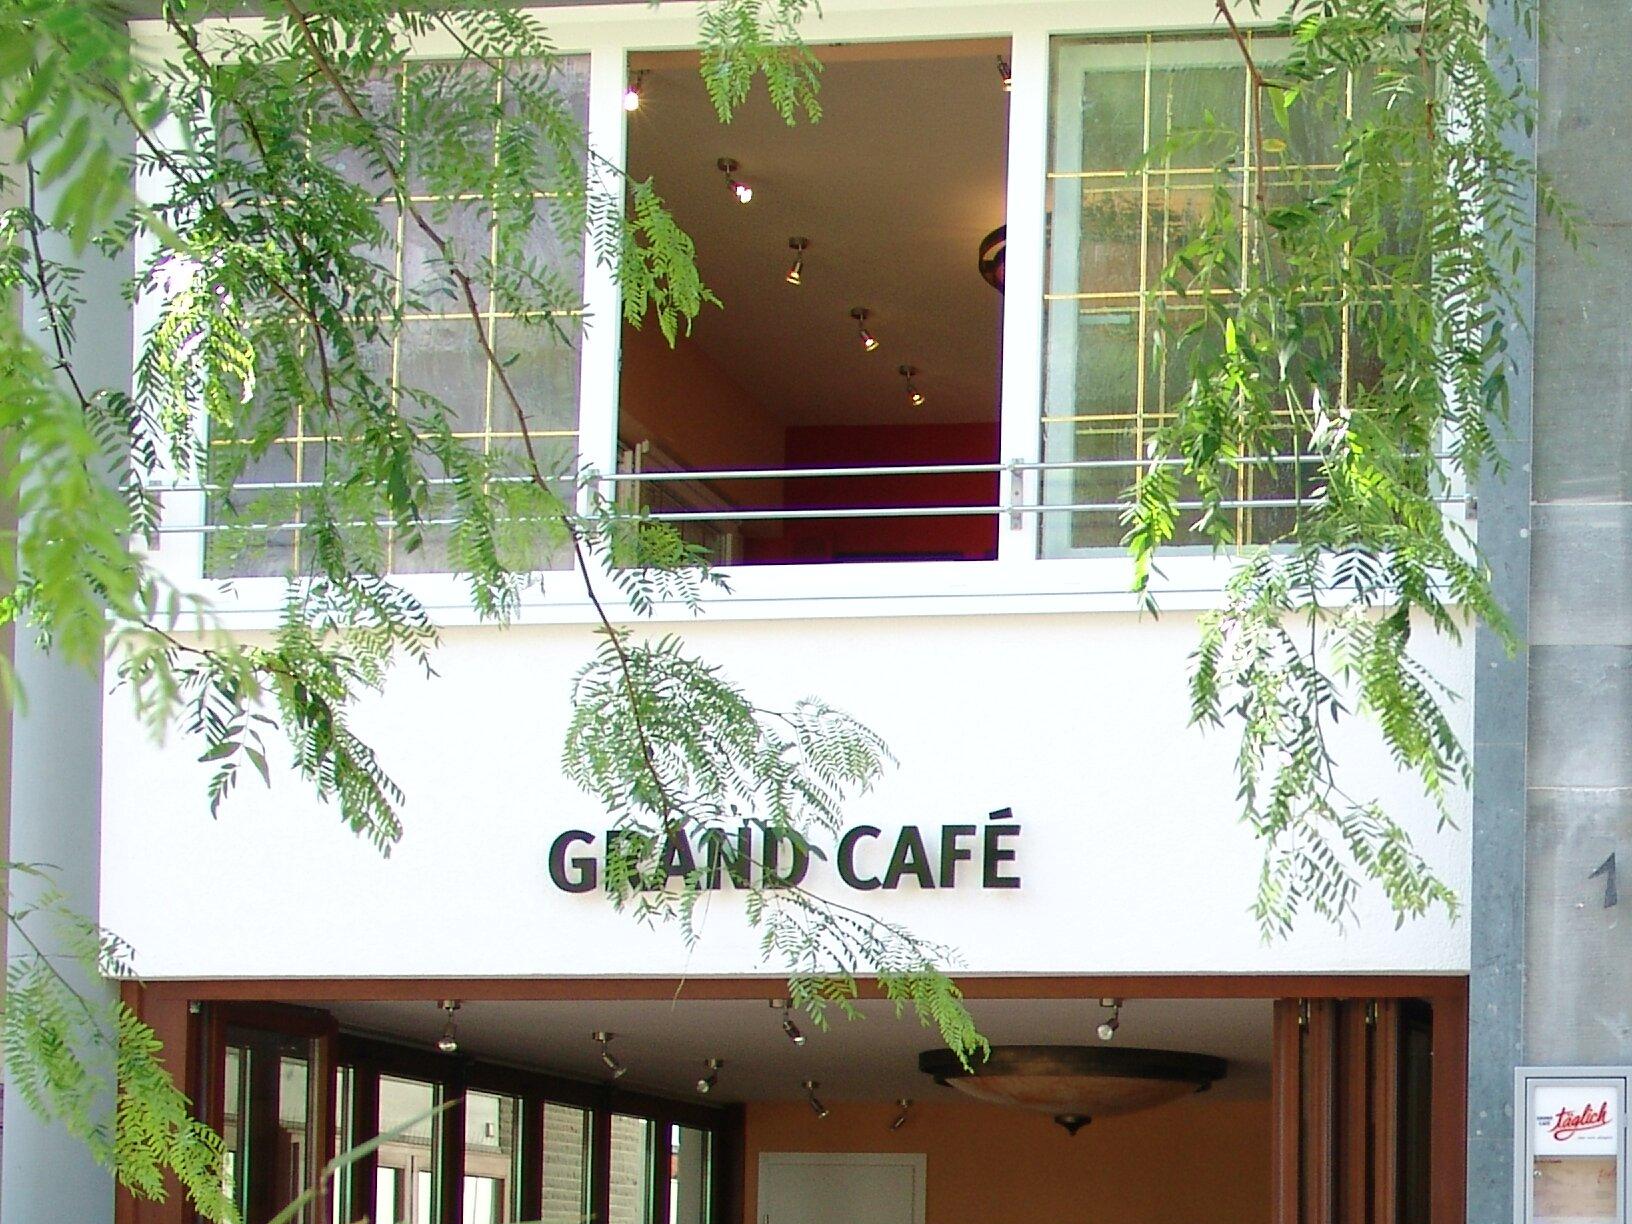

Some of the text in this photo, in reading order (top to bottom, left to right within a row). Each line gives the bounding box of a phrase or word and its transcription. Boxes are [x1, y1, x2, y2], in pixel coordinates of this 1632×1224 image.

[836, 807, 1022, 891] CAFÉ
[1588, 852, 1617, 909] 1
[1547, 1101, 1613, 1141] täglich
